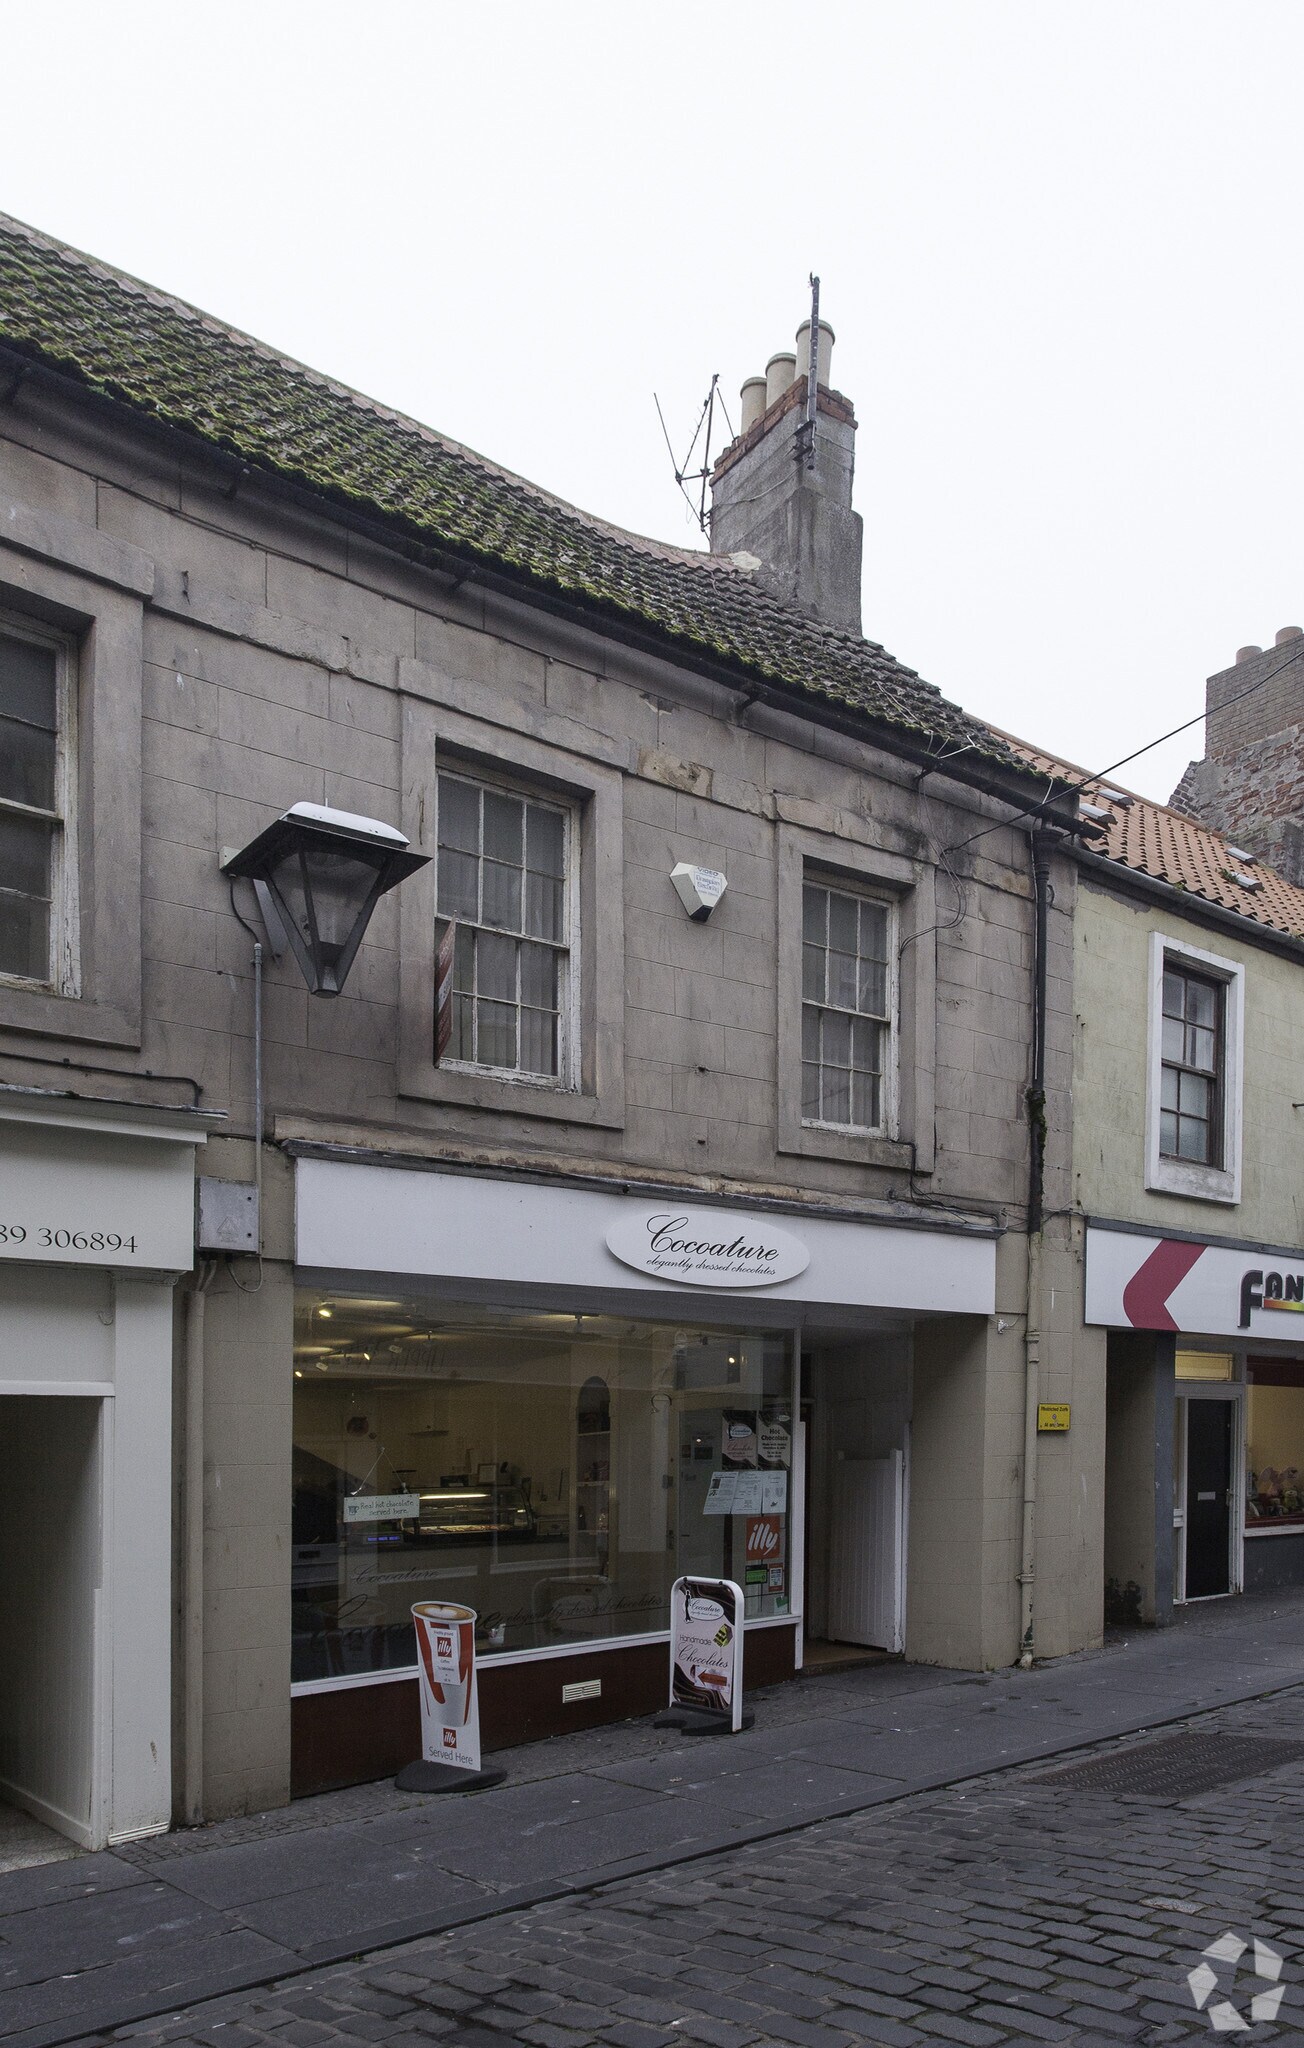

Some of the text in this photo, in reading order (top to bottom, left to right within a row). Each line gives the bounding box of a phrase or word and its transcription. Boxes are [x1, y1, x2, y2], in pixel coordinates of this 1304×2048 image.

[37, 1227, 138, 1253] 306894
[646, 1214, 779, 1261] Cocoature
[646, 1255, 776, 1276] elegantly dressed chocolates
[360, 1502, 374, 1510] Real
[386, 1499, 414, 1508] chocolate
[747, 1523, 778, 1555] illy
[438, 1639, 452, 1656] illy
[680, 1634, 712, 1645] Handmade
[678, 1642, 728, 1668] Chocolates
[444, 1731, 456, 1746] illy
[428, 1746, 473, 1765] Served Here
